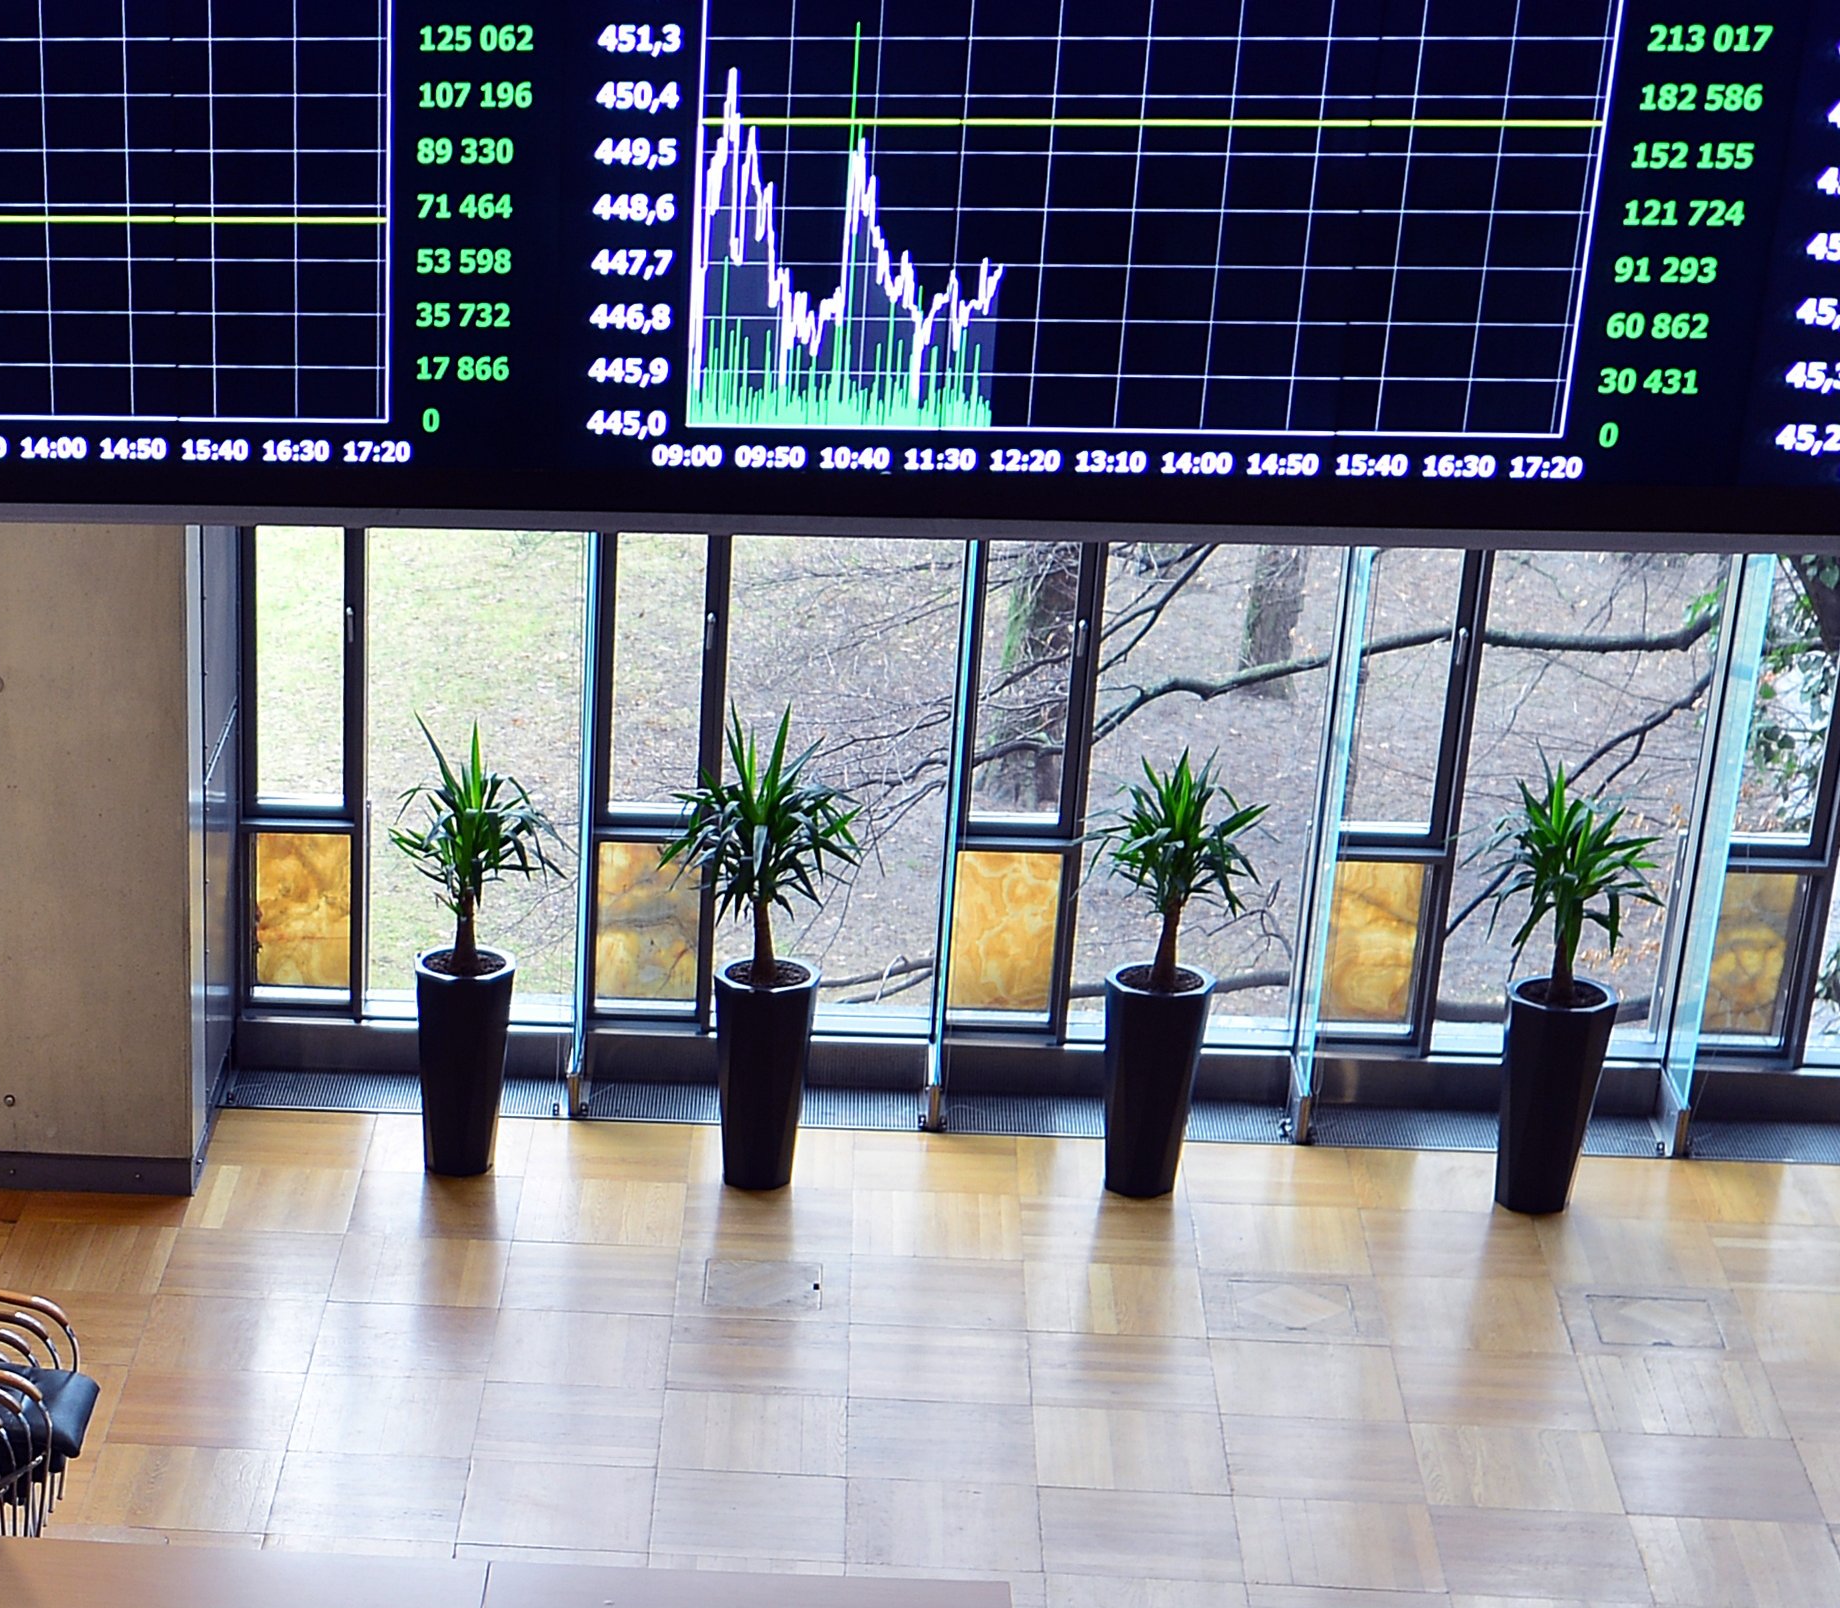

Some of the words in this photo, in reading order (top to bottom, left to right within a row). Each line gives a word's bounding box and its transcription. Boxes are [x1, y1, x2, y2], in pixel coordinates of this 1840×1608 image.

[419, 24, 472, 52] 125
[479, 24, 534, 52] 062
[597, 23, 681, 58] 451,3
[1647, 23, 1707, 53] 213
[1713, 24, 1774, 53] 017
[419, 81, 472, 109] 107
[480, 81, 533, 109] 196
[595, 81, 680, 114] 450,4
[1639, 82, 1698, 112] 182
[1704, 83, 1764, 112] 586
[416, 137, 453, 165] 89
[460, 137, 514, 165] 330
[594, 137, 677, 170] 449,5
[1631, 141, 1689, 170] 152
[1696, 142, 1755, 170] 155
[416, 193, 452, 219] 71
[458, 193, 513, 220] 464
[592, 193, 675, 226] 448,6
[1622, 198, 1678, 226] 121
[1687, 199, 1745, 227] 724
[416, 247, 451, 274] 53
[459, 248, 512, 275] 598
[591, 248, 673, 281] 447,7
[1614, 255, 1651, 283] 91
[1659, 256, 1718, 284] 293
[415, 301, 451, 328] 35
[458, 302, 511, 328] 732
[589, 303, 671, 335] 446,8
[1606, 312, 1646, 339] 60
[1651, 312, 1709, 340] 862
[416, 356, 451, 380] 17
[457, 355, 510, 382] 866
[587, 357, 669, 388] 445,9
[1597, 367, 1637, 395] 30
[1642, 368, 1699, 395] 431
[422, 407, 440, 433] 0
[586, 409, 667, 440] 445,0
[20, 436, 87, 459] 14:00
[99, 437, 167, 460] 14:50
[181, 438, 249, 461] 15:40
[262, 439, 330, 462] 16:30
[343, 440, 411, 463] 17:20
[1598, 422, 1619, 448] 0
[651, 444, 723, 467] 09:00
[734, 445, 806, 468] 09:50
[819, 446, 890, 470] 10:40
[903, 448, 977, 471] 11:30
[989, 448, 1061, 472] 12:20
[1074, 449, 1147, 473] 13:10
[1160, 451, 1233, 475] 14:00
[1246, 453, 1320, 476] 14:50
[1335, 453, 1408, 477] 15:40
[1422, 454, 1496, 478] 16:30
[1509, 455, 1583, 479] 17:20
